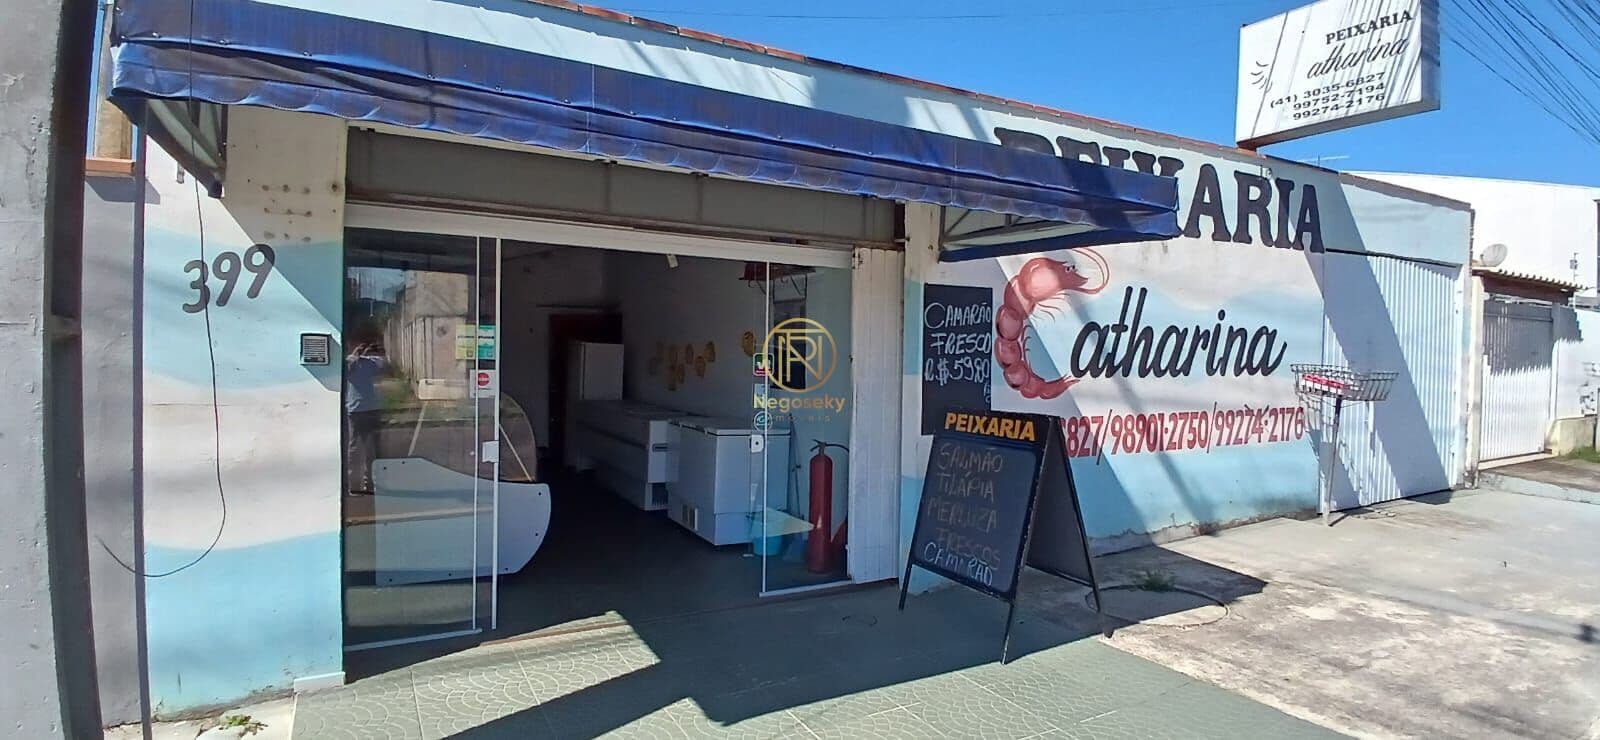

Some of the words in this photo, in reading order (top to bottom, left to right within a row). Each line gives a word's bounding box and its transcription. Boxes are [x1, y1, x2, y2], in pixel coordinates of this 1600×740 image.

[1326, 10, 1413, 45] PEIXARIA
[1307, 37, 1410, 79] atharina
[1270, 94, 1298, 109] (41)
[1303, 72, 1386, 100] 3035-6827
[1293, 82, 1386, 111] 99752-7194
[1293, 93, 1386, 120] 99274-2176
[994, 127, 1325, 253] ARIA
[182, 243, 276, 314] 399
[924, 302, 991, 328] CAMARÃO
[1070, 286, 1287, 378] atharina
[930, 332, 991, 355] FRESCO
[944, 412, 1037, 442] PEIXARIA
